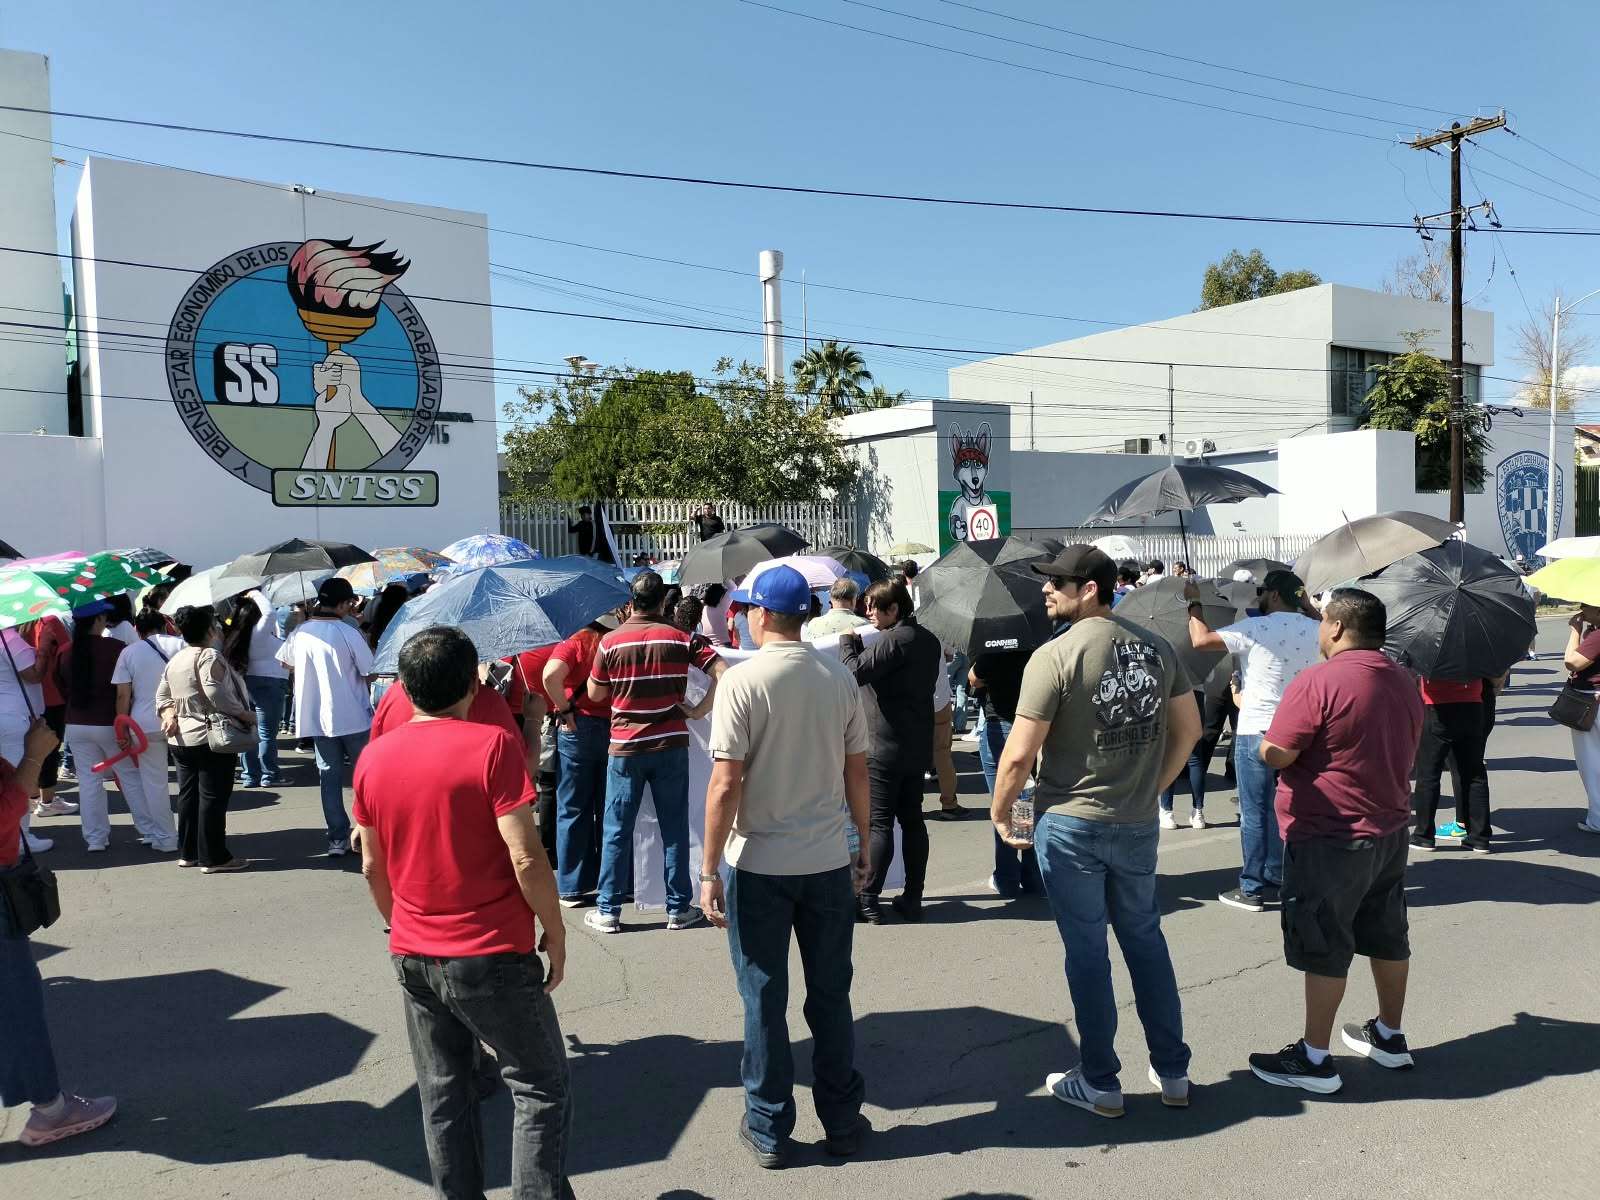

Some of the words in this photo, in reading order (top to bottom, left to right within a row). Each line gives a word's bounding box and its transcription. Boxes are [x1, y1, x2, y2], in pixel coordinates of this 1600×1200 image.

[235, 250, 261, 271] DE
[258, 246, 289, 264] LOS
[214, 341, 280, 405] SS
[397, 302, 438, 458] TRABAJADORES
[170, 349, 230, 458] BIENESTAR
[234, 461, 250, 478] Y
[289, 472, 425, 502] SNTSS
[975, 517, 989, 532] 40
